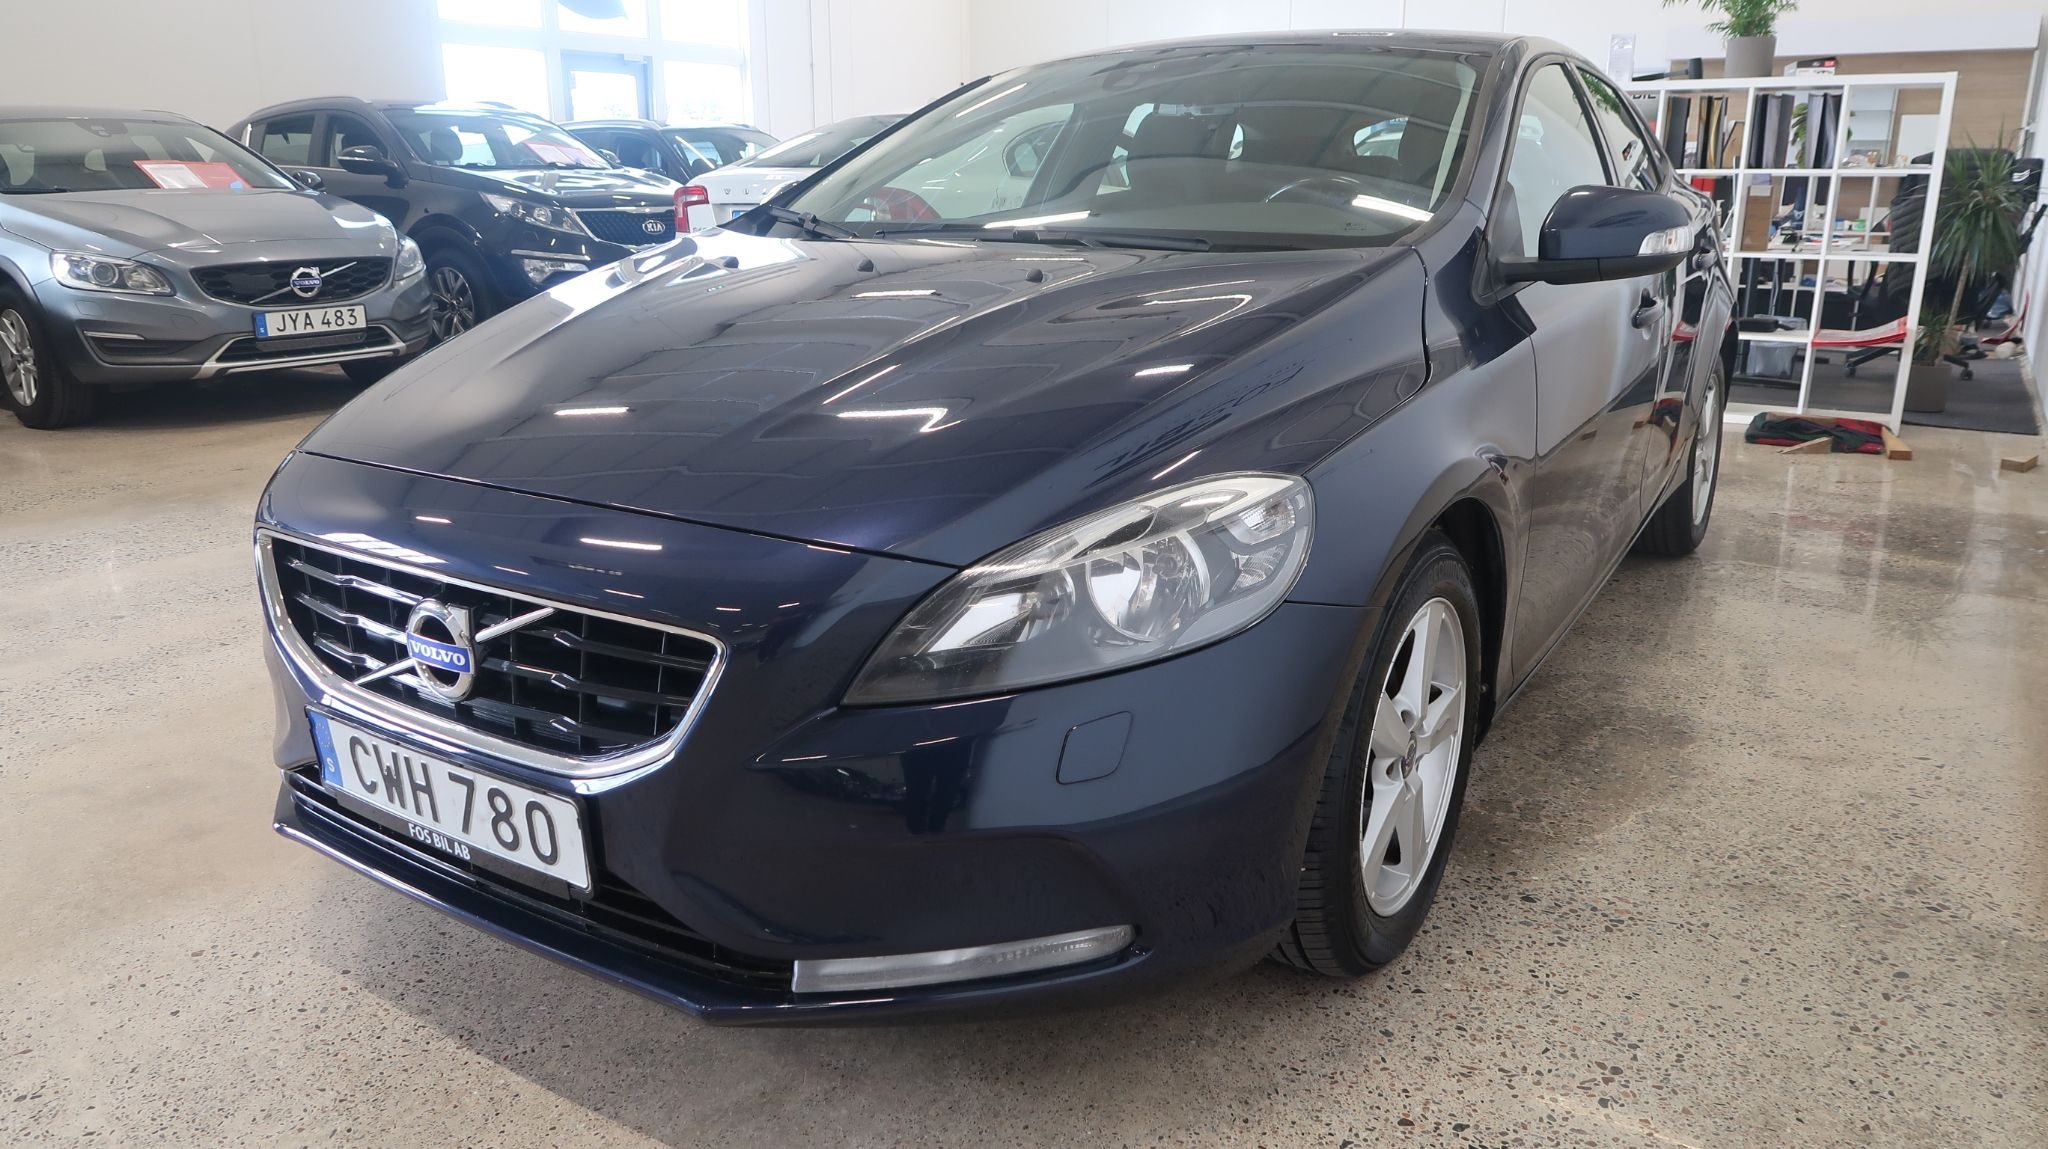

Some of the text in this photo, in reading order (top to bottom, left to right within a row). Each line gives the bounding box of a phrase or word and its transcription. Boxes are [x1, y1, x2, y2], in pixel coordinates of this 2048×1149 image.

[646, 221, 664, 232] KIA
[276, 308, 358, 332] JYA 483
[409, 639, 466, 666] VOLVO
[326, 757, 336, 773] S
[349, 734, 559, 866] CWH 780
[408, 822, 471, 860] FOS BIL AB
